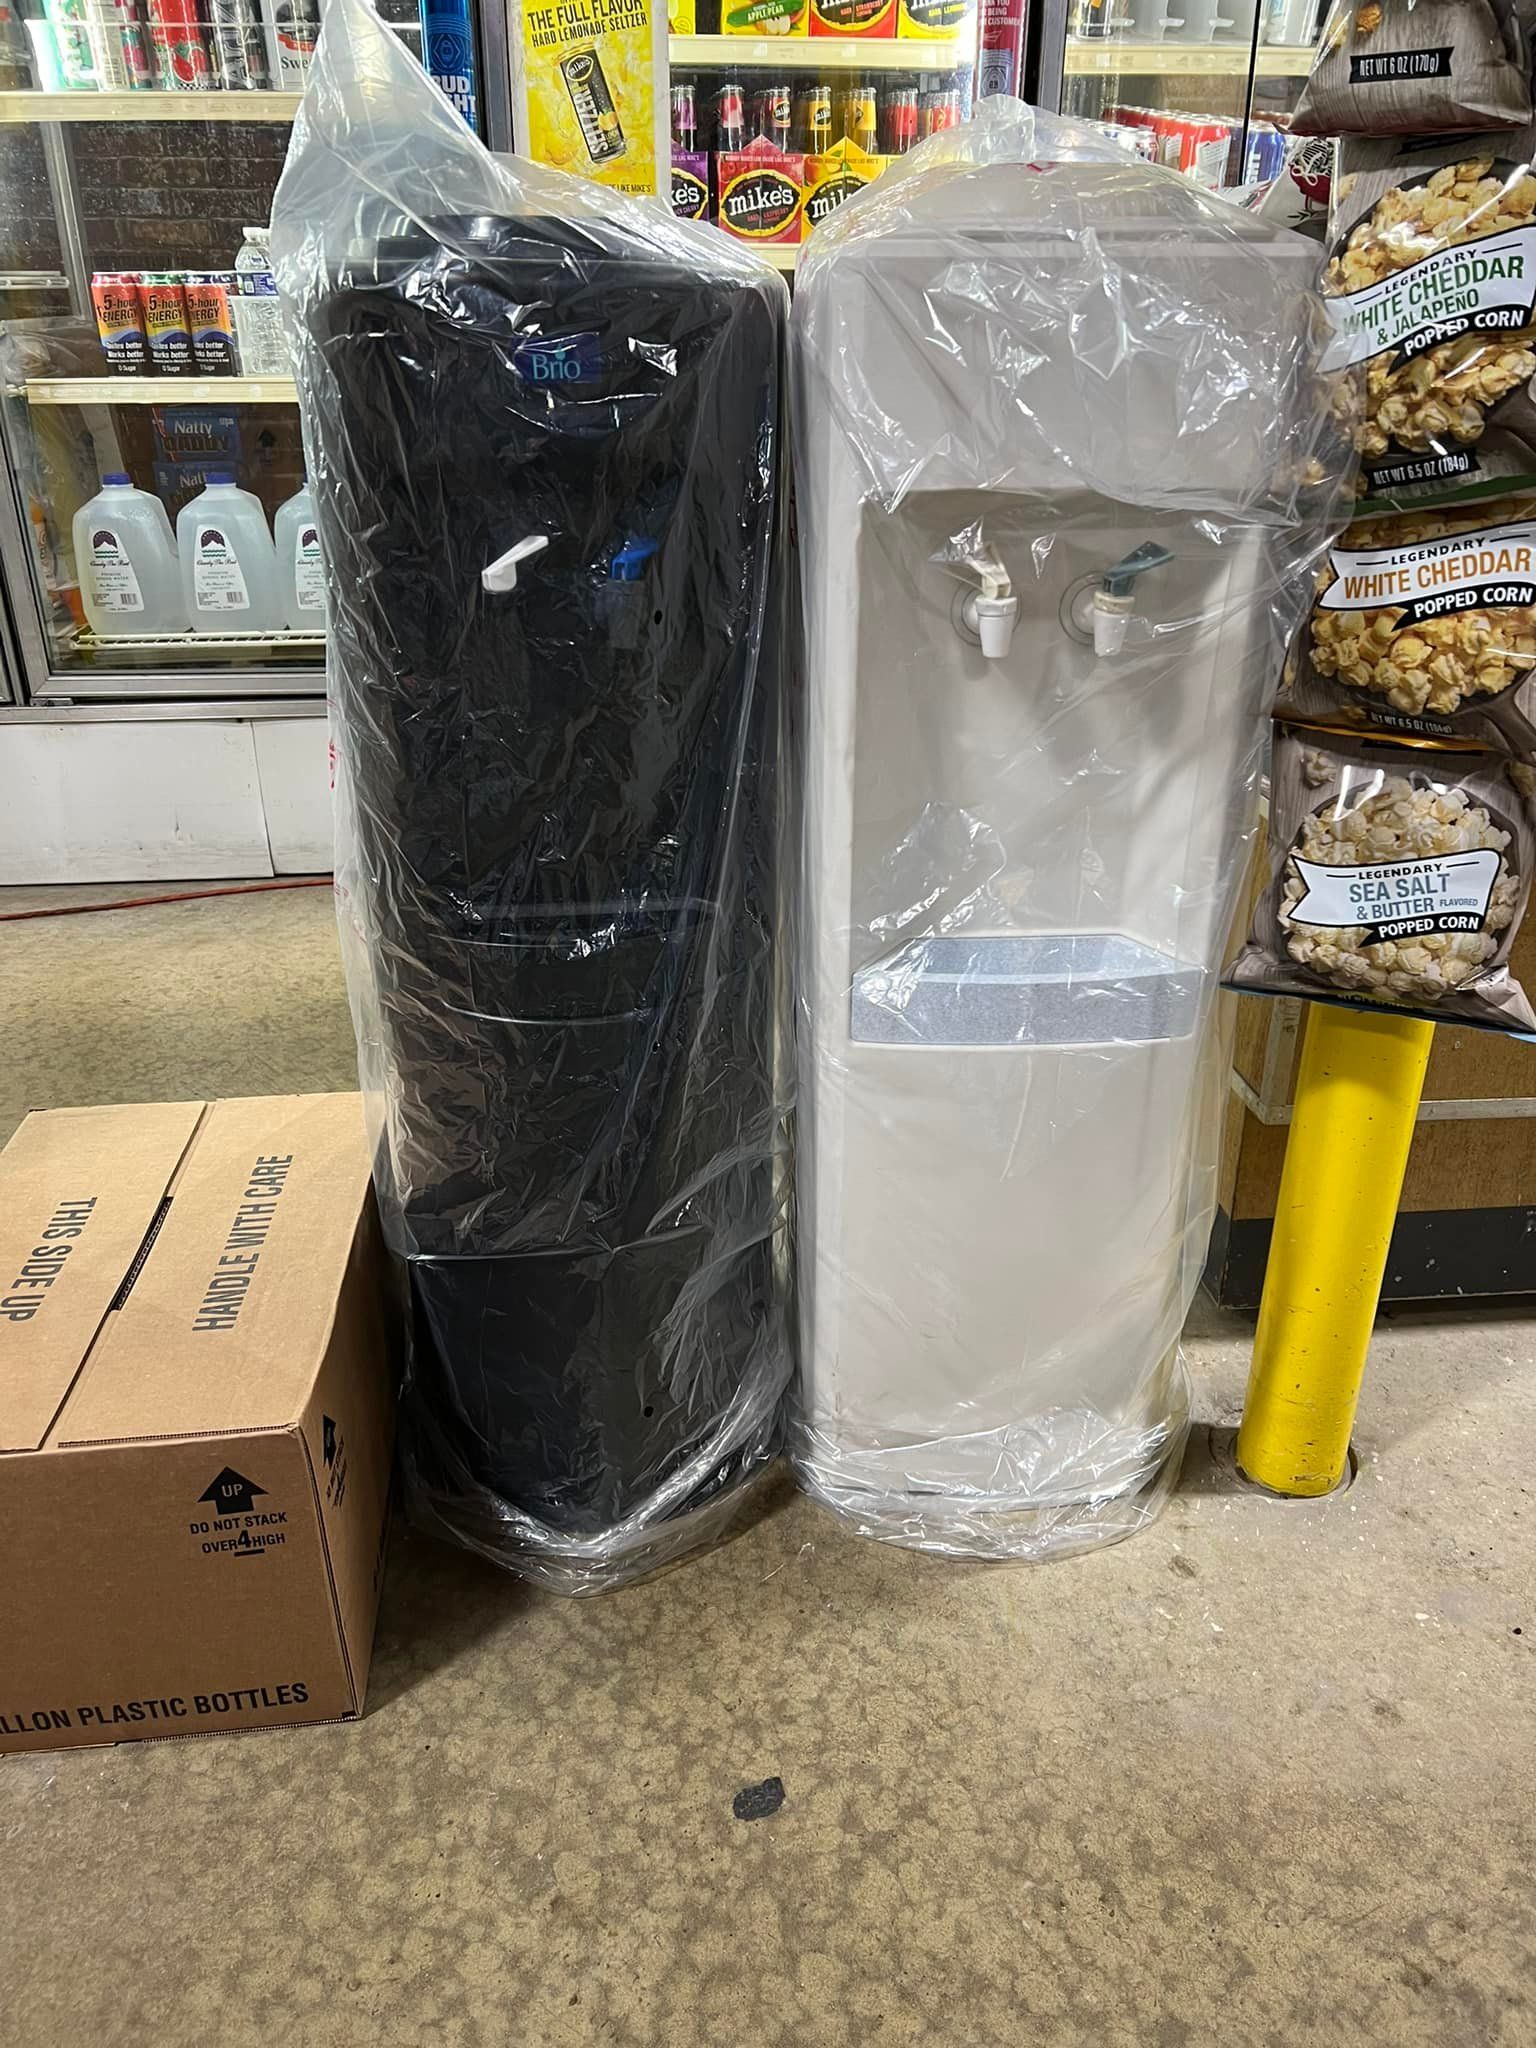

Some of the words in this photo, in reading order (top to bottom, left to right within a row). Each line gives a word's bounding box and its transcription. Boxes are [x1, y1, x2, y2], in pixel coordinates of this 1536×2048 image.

[528, 9, 555, 31] THE
[557, 2, 590, 27] FULL
[593, 0, 644, 18] FLAVOR
[531, 32, 557, 48] HARD
[559, 20, 607, 42] LEMONADE
[609, 12, 648, 32] SELTZER
[748, 9, 766, 22] APPLE
[1360, 58, 1374, 76] NET
[1375, 57, 1388, 75] WT
[1390, 57, 1395, 74] 6
[1397, 56, 1408, 73] OZ
[1410, 52, 1440, 75] (170g)
[573, 84, 609, 154] SELTZER
[729, 185, 794, 216] mike's
[1384, 248, 1478, 295] LEGENDARY
[1343, 296, 1403, 337] WHITE
[1409, 255, 1524, 306] CHEDDAR
[148, 309, 184, 323] ENERGY
[1377, 327, 1389, 346] &
[1392, 288, 1480, 341] JALAPEÑO
[1404, 317, 1468, 356] POPPED
[1474, 310, 1524, 328] CORN
[531, 352, 581, 381] Brio
[174, 420, 212, 438] Natty
[1373, 469, 1390, 486] NET
[1391, 466, 1406, 483] WT
[1407, 463, 1422, 480] 6.5
[1424, 461, 1437, 477] OZ
[1391, 536, 1486, 566] LEGENDARY
[1344, 568, 1411, 599] WHITE
[1417, 547, 1531, 588] CHEDDAR
[1414, 591, 1478, 618] POPPED
[1482, 587, 1533, 604] CORN
[1358, 862, 1443, 880] LEGENDARY
[1348, 880, 1389, 903] SEA
[1395, 873, 1450, 897] SALT
[1356, 907, 1369, 921] &
[1372, 897, 1434, 919] BUTTER
[1439, 898, 1479, 908] FLAVORED
[1378, 918, 1434, 939] POPPED
[1439, 916, 1479, 930] CORN
[244, 1154, 294, 1200] CARE
[41, 1196, 98, 1241] THIS
[224, 1202, 278, 1251] WITH
[11, 1245, 73, 1290] SIDE
[191, 1252, 260, 1332] HANDLE
[0, 1294, 46, 1322] UP
[221, 1483, 244, 1498] UP
[190, 1520, 209, 1534] DO
[214, 1517, 240, 1532] NOT
[245, 1512, 287, 1527] STACK
[202, 1540, 238, 1554] OVER
[238, 1530, 252, 1548] 4
[252, 1532, 286, 1547] HIGH
[0, 1709, 72, 1735] LLON
[78, 1698, 188, 1726] PLASTIC
[194, 1682, 309, 1715] BOTTLES
